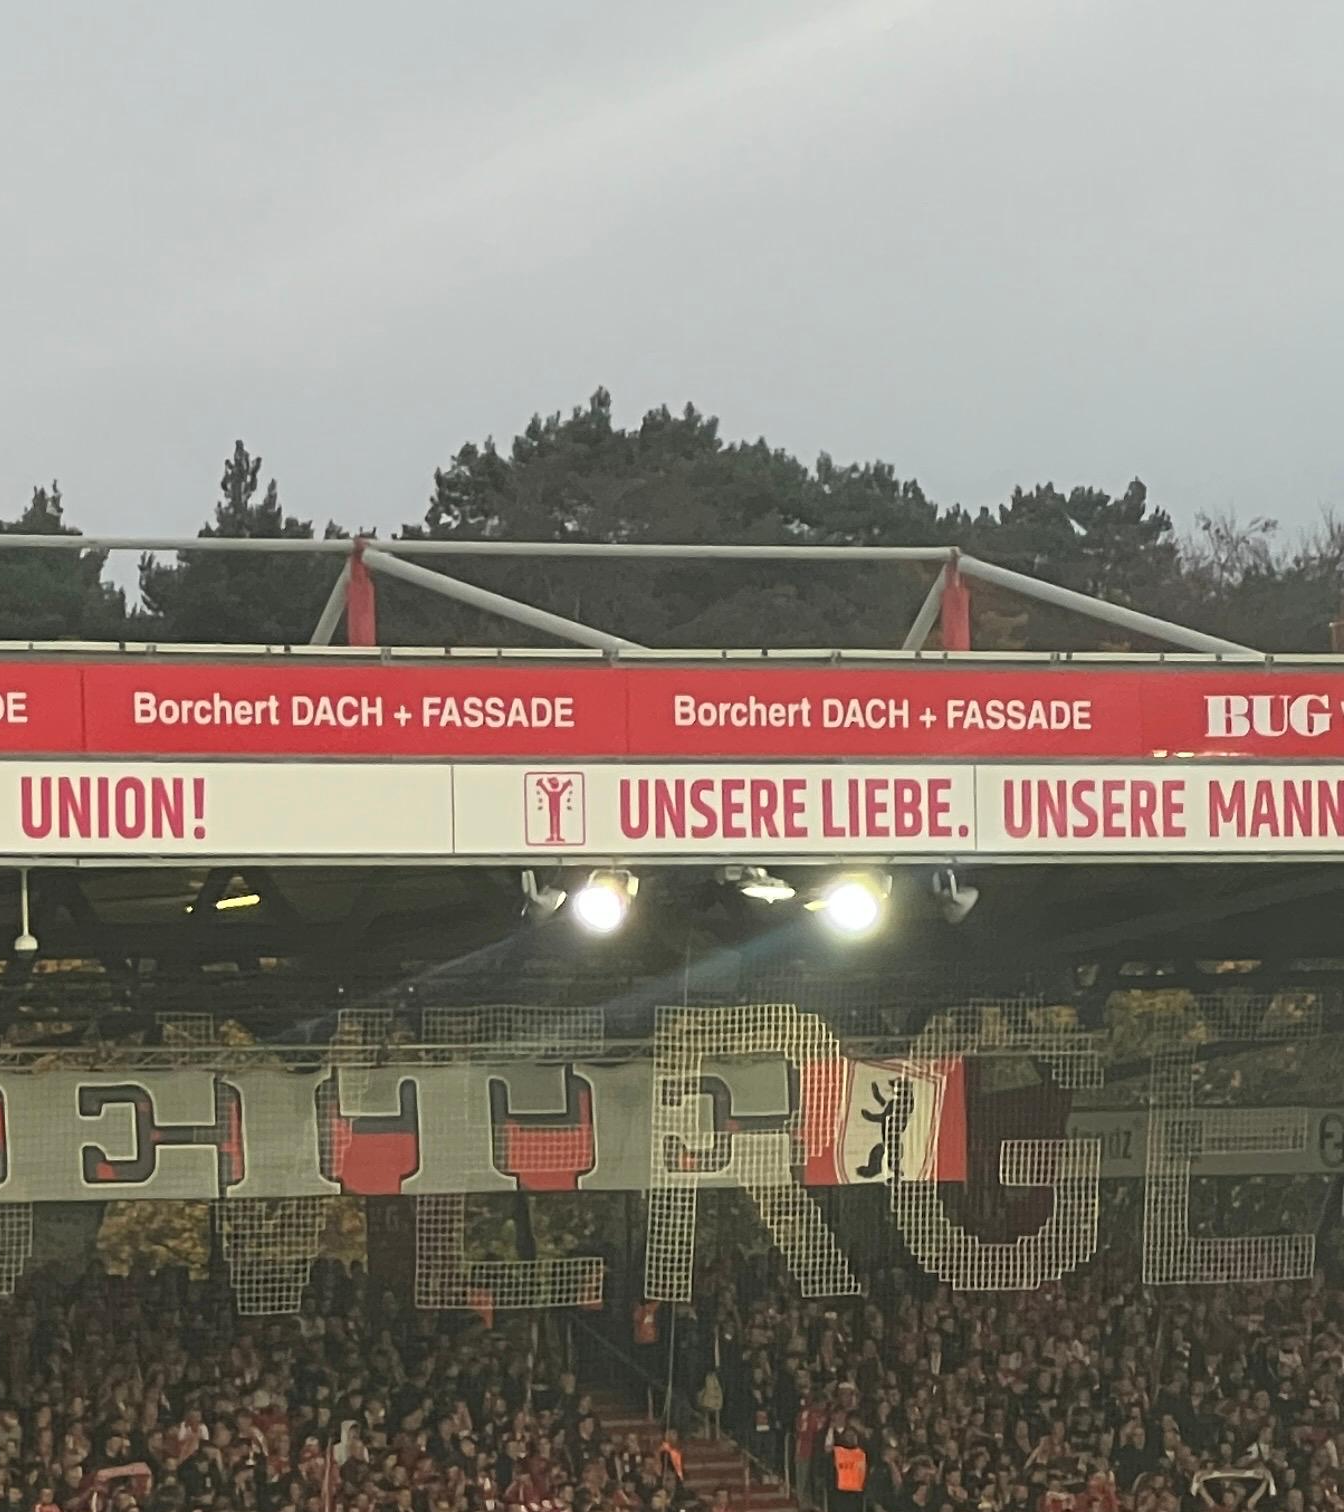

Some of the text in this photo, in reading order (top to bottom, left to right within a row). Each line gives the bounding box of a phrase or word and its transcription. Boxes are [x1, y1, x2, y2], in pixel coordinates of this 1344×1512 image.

[133, 691, 280, 727] Borchert
[291, 696, 383, 728] DACH
[422, 696, 575, 729] FASSADE
[674, 695, 811, 729] Borchert
[823, 698, 909, 729] DACH
[947, 698, 1091, 731] FASSADE
[1204, 694, 1333, 737] BUG
[20, 776, 207, 840] UNION!
[619, 778, 807, 840] UNSERE
[821, 779, 970, 840] LIEBE.
[1003, 779, 1186, 840] UNSERE
